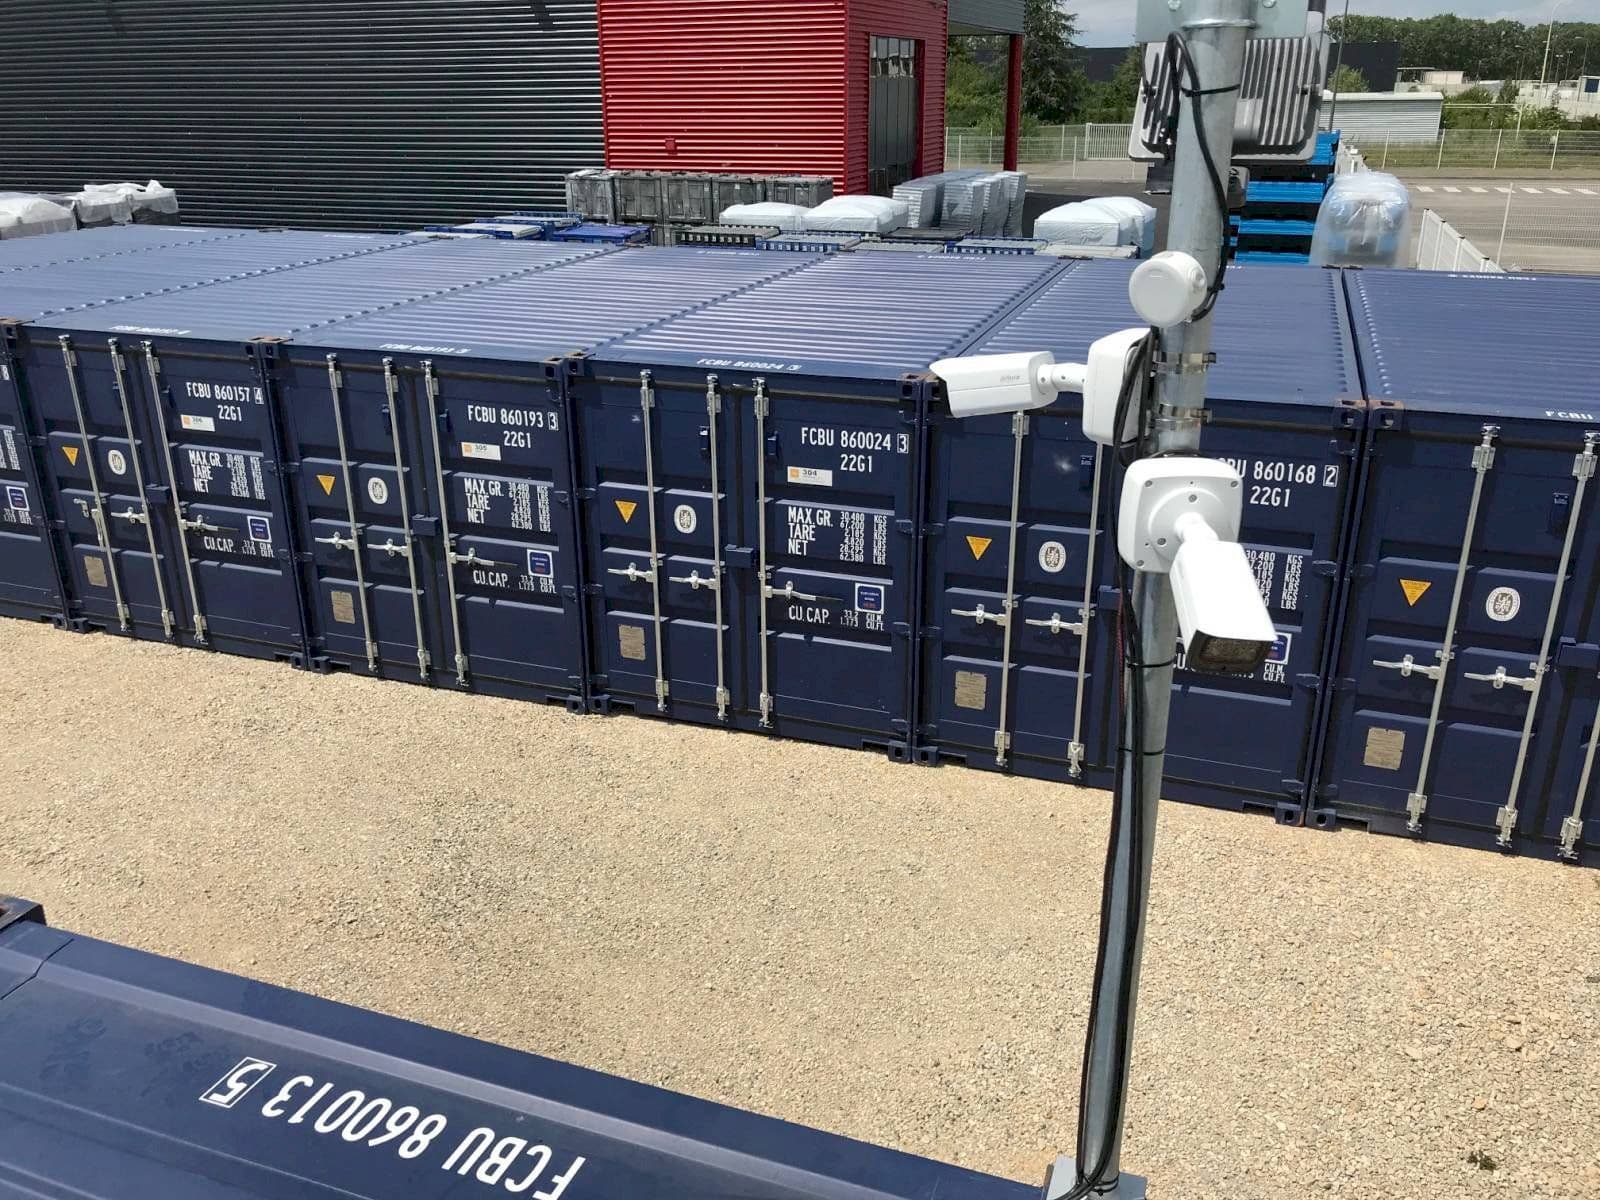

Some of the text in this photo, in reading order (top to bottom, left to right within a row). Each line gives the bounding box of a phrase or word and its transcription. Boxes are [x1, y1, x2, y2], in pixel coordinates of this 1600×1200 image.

[186, 382, 264, 404] FCBU 860157 4
[217, 404, 242, 422] 22G1
[467, 404, 558, 430] FCBU 860193 3
[503, 430, 532, 449] 22G1
[801, 427, 909, 453] FCBU 860024 3
[191, 463, 213, 480] TARE
[840, 453, 873, 473] 22G1
[1253, 461, 1316, 484] 860168
[1323, 465, 1338, 487] 2
[193, 477, 209, 493] NET
[466, 493, 491, 510] TARE
[1249, 485, 1290, 507] 22G1
[467, 507, 484, 524] NET
[840, 511, 865, 522] 30.480
[788, 523, 816, 541] TARE
[844, 529, 864, 537] 2.185
[840, 520, 865, 530] 67.200
[788, 538, 808, 556] NET
[840, 552, 864, 562] 62.380
[1287, 554, 1303, 565] KGS
[1249, 559, 1302, 573] 7.200 LBS
[1285, 571, 1301, 582] KGS
[1282, 589, 1298, 600] KGS
[1283, 581, 1299, 592] LBS
[1281, 599, 1297, 610] LBS
[204, 1059, 587, 1200] FCBU 860013 5
